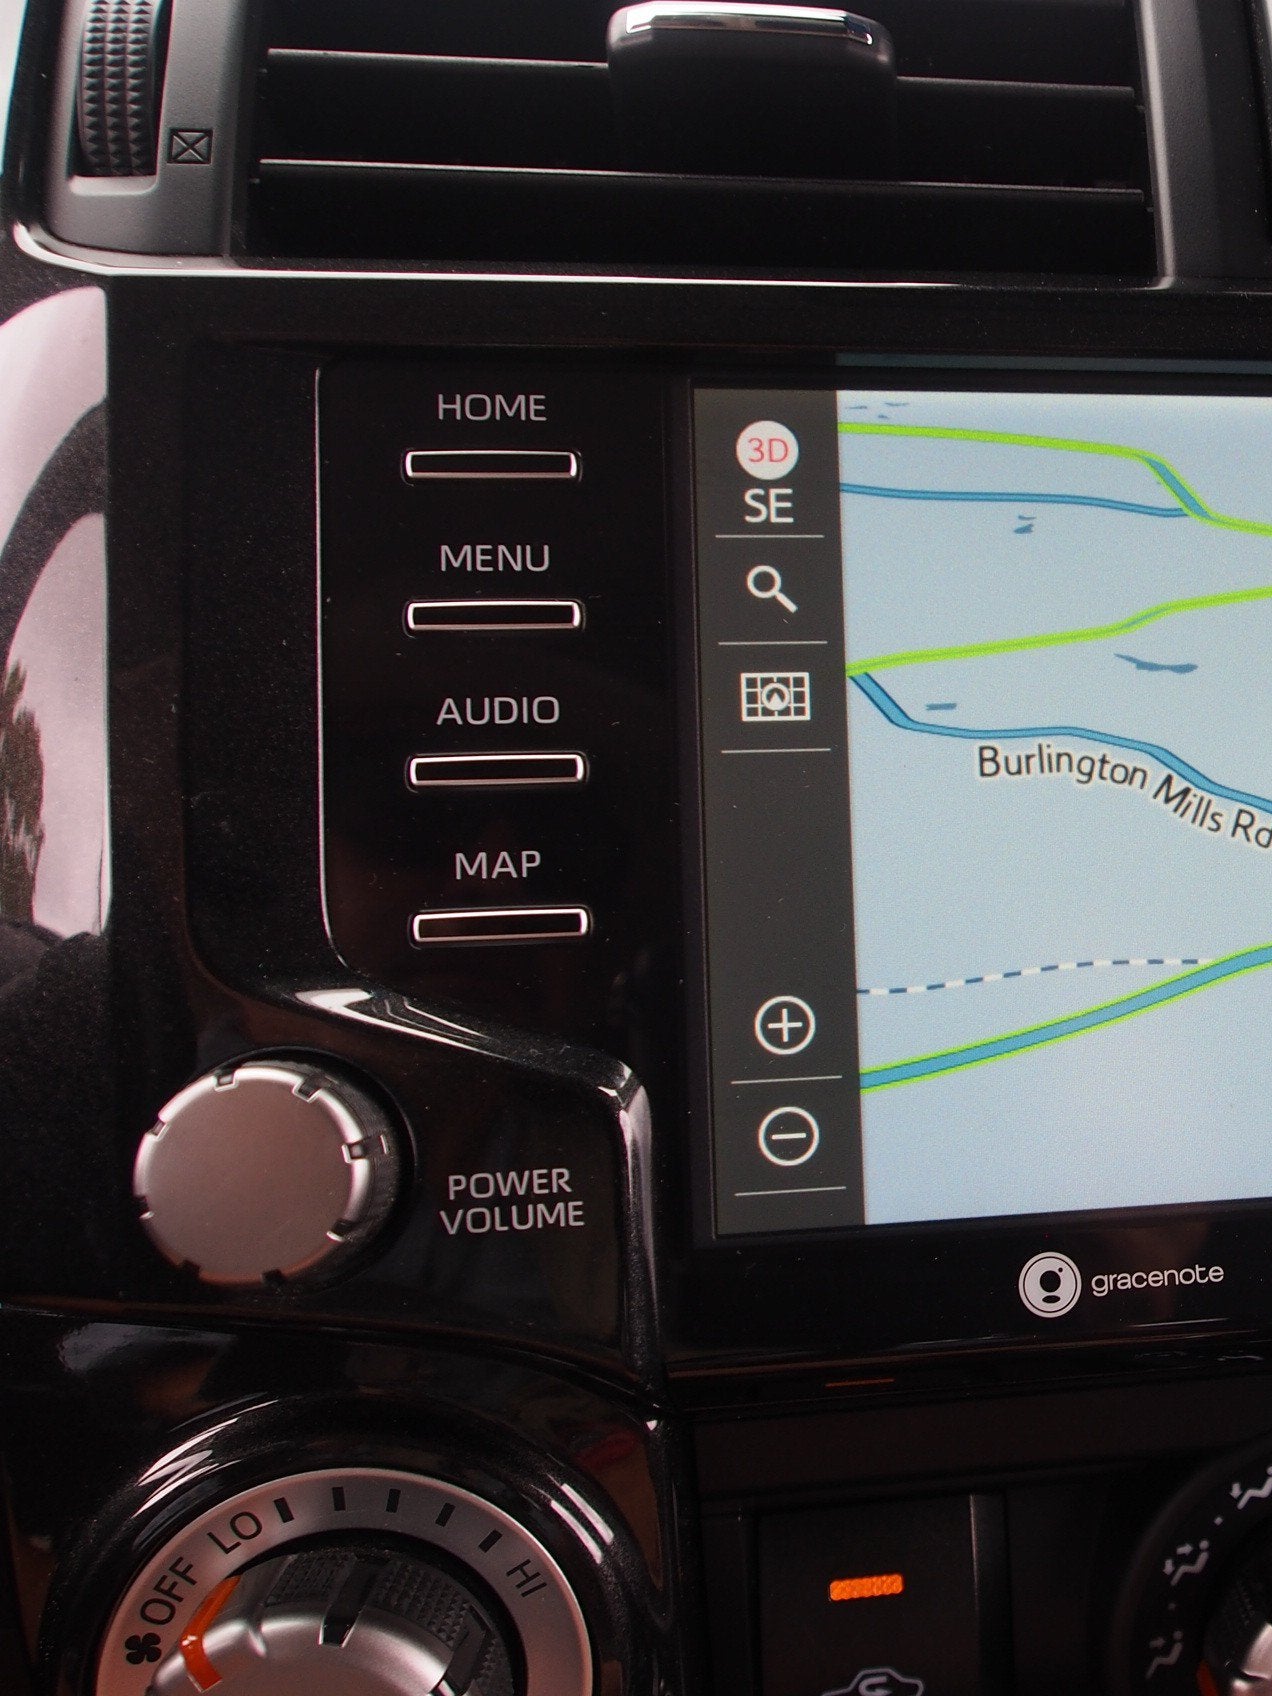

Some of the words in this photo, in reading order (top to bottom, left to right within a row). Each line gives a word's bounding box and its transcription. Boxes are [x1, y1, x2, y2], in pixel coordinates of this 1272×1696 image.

[437, 393, 548, 422] HOME
[746, 436, 790, 464] 3D
[743, 487, 795, 524] SE
[439, 543, 551, 573] MENU
[436, 695, 561, 726] AUDIO
[977, 742, 1148, 790] Burlington
[1152, 772, 1225, 834] Mills
[453, 849, 543, 881] MAP
[447, 1166, 573, 1200] POWER
[438, 1200, 586, 1236] VOLUME
[1091, 1264, 1225, 1298] gracenote
[206, 1509, 264, 1556] LO
[139, 1555, 200, 1629] OFF
[504, 1557, 549, 1600] HI
